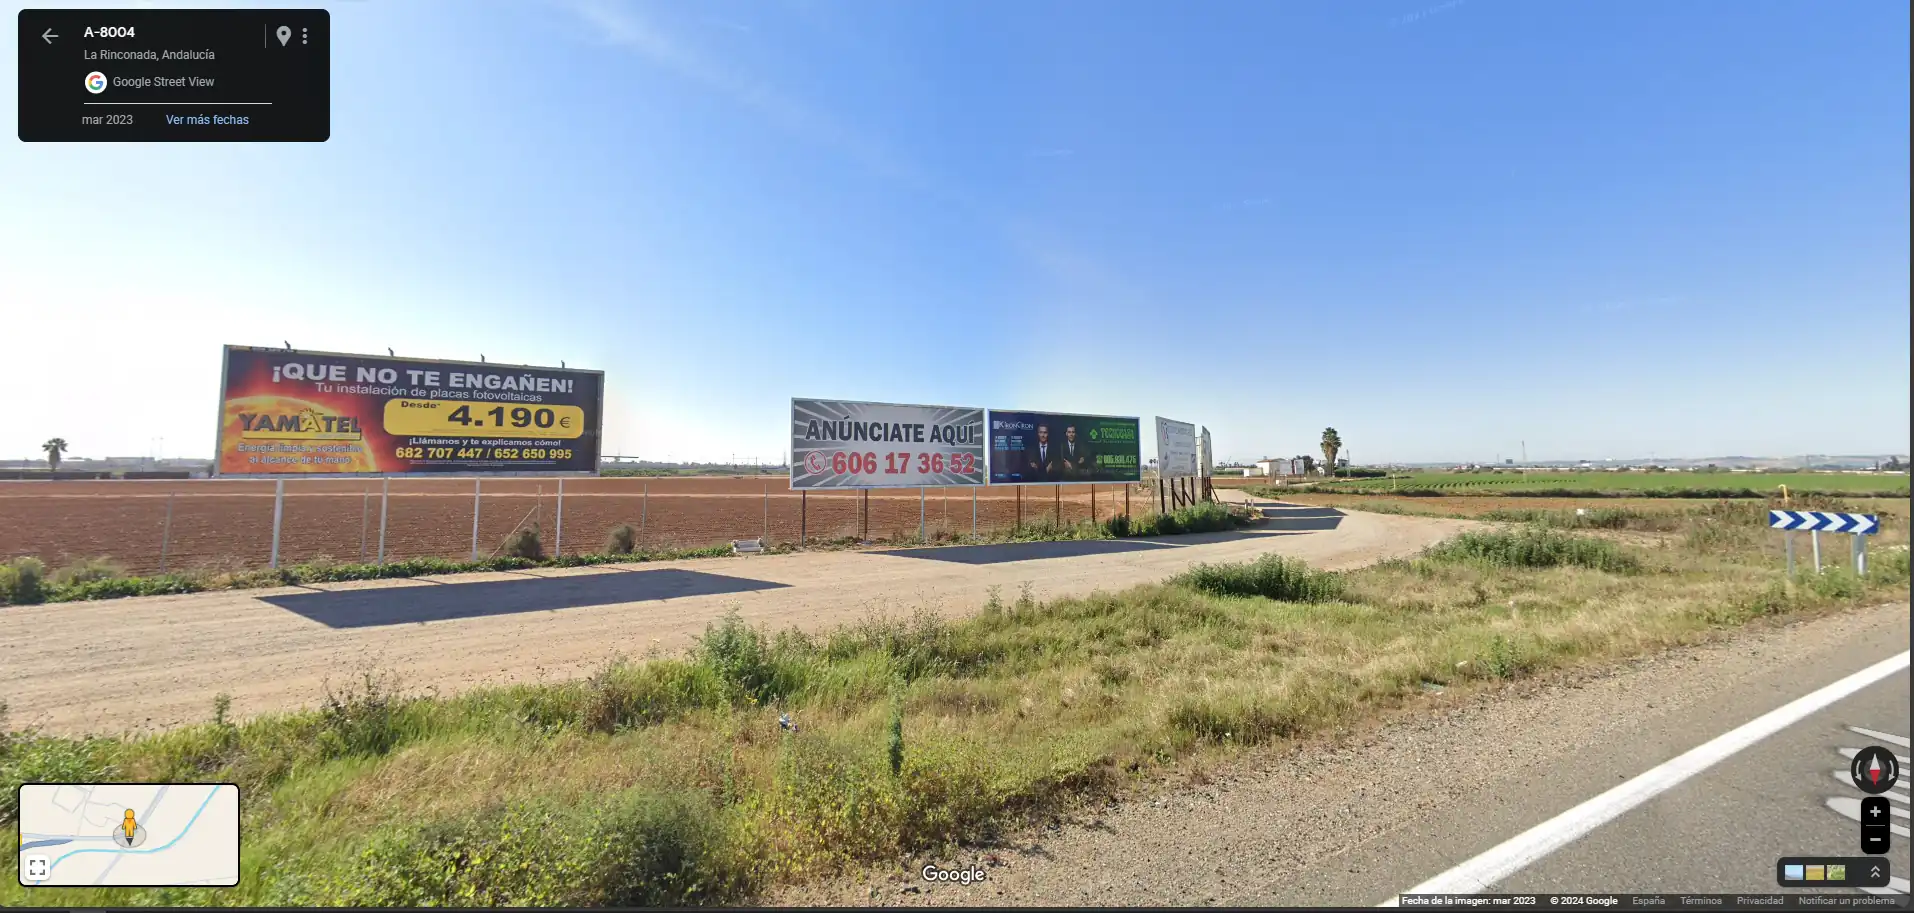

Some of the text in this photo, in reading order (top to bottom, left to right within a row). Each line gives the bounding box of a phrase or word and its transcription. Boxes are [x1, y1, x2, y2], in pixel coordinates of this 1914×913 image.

[272, 362, 575, 394] ¡QUE NO TE ENGAÑEN!
[315, 382, 543, 403] Tu instalación de placas fotovoltaicas
[238, 411, 362, 433] YAMATEL
[447, 404, 572, 429] 4.190 €
[804, 414, 925, 443] ANÚNCIATE
[929, 420, 976, 447] AQUÍ
[395, 446, 424, 460] 682
[427, 447, 453, 460] 707
[456, 447, 483, 460] 447
[494, 448, 519, 460] 652
[522, 448, 546, 460] 650
[549, 448, 573, 460] 995
[462, 438, 469, 447] y
[470, 437, 480, 446] te
[481, 437, 533, 448] explicamos
[831, 451, 976, 476] 606 17 36 52
